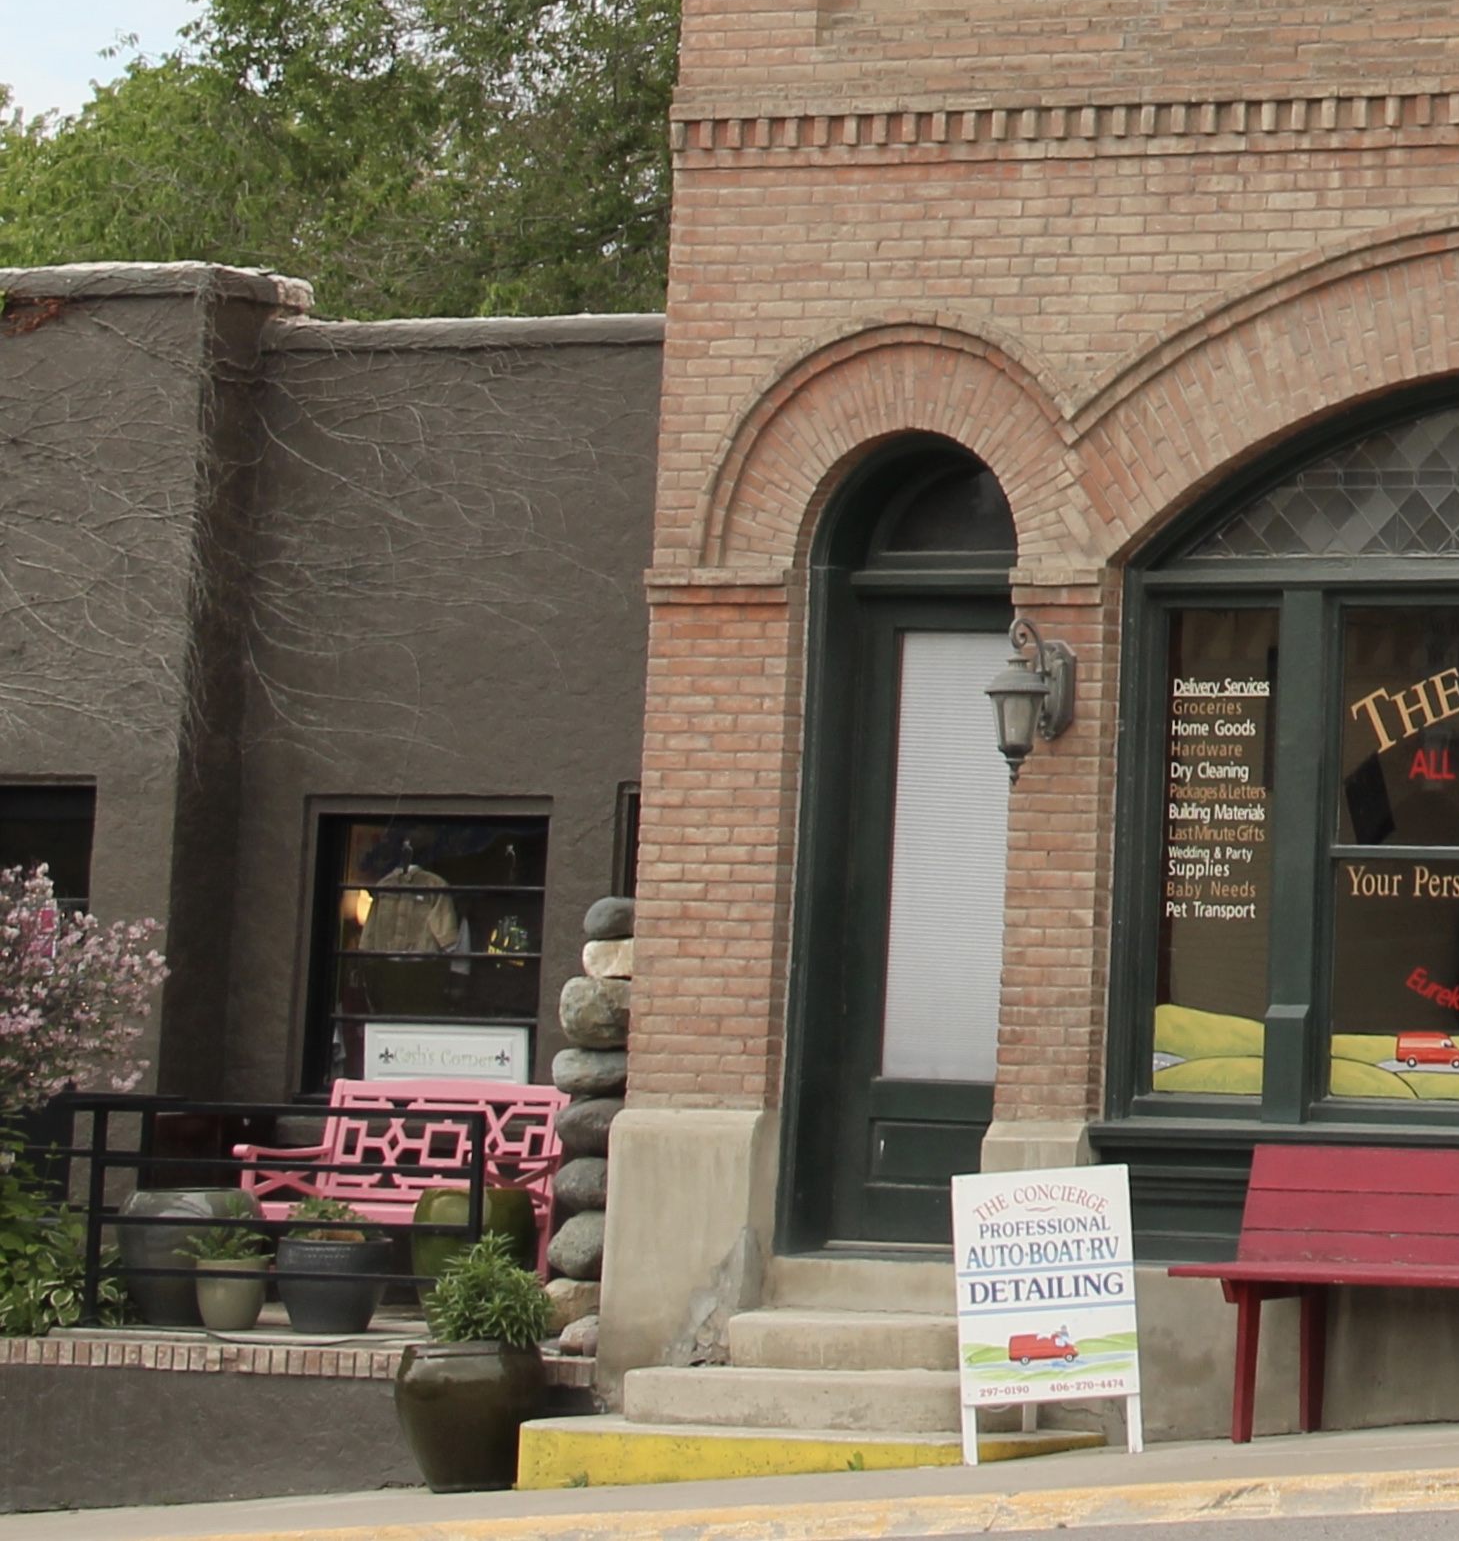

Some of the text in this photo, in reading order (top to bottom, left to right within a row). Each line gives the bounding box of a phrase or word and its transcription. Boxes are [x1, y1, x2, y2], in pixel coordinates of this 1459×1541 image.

[1173, 677, 1270, 698] Delivery Services
[1173, 699, 1243, 715] Groceries
[1171, 719, 1256, 736] Home Goods
[1171, 741, 1243, 757] Hardware
[1171, 761, 1250, 782] Dry Cleaning
[1409, 749, 1455, 780] ALL
[1169, 803, 1265, 824] Building Materials
[1168, 846, 1253, 863] Wedding & Party
[1168, 859, 1230, 880] Supplies
[1167, 880, 1256, 900] Baby Needs
[1348, 865, 1401, 897] Your
[1166, 901, 1256, 920] Pet Transport
[394, 1044, 496, 1068] Cash's Corner
[973, 1184, 1109, 1222] THE CONCIERGE
[979, 1215, 1111, 1240] PROFESSIONAL
[969, 1271, 1125, 1305] DETAILING
[979, 1378, 1125, 1398] 297-0190 406-270-4474
